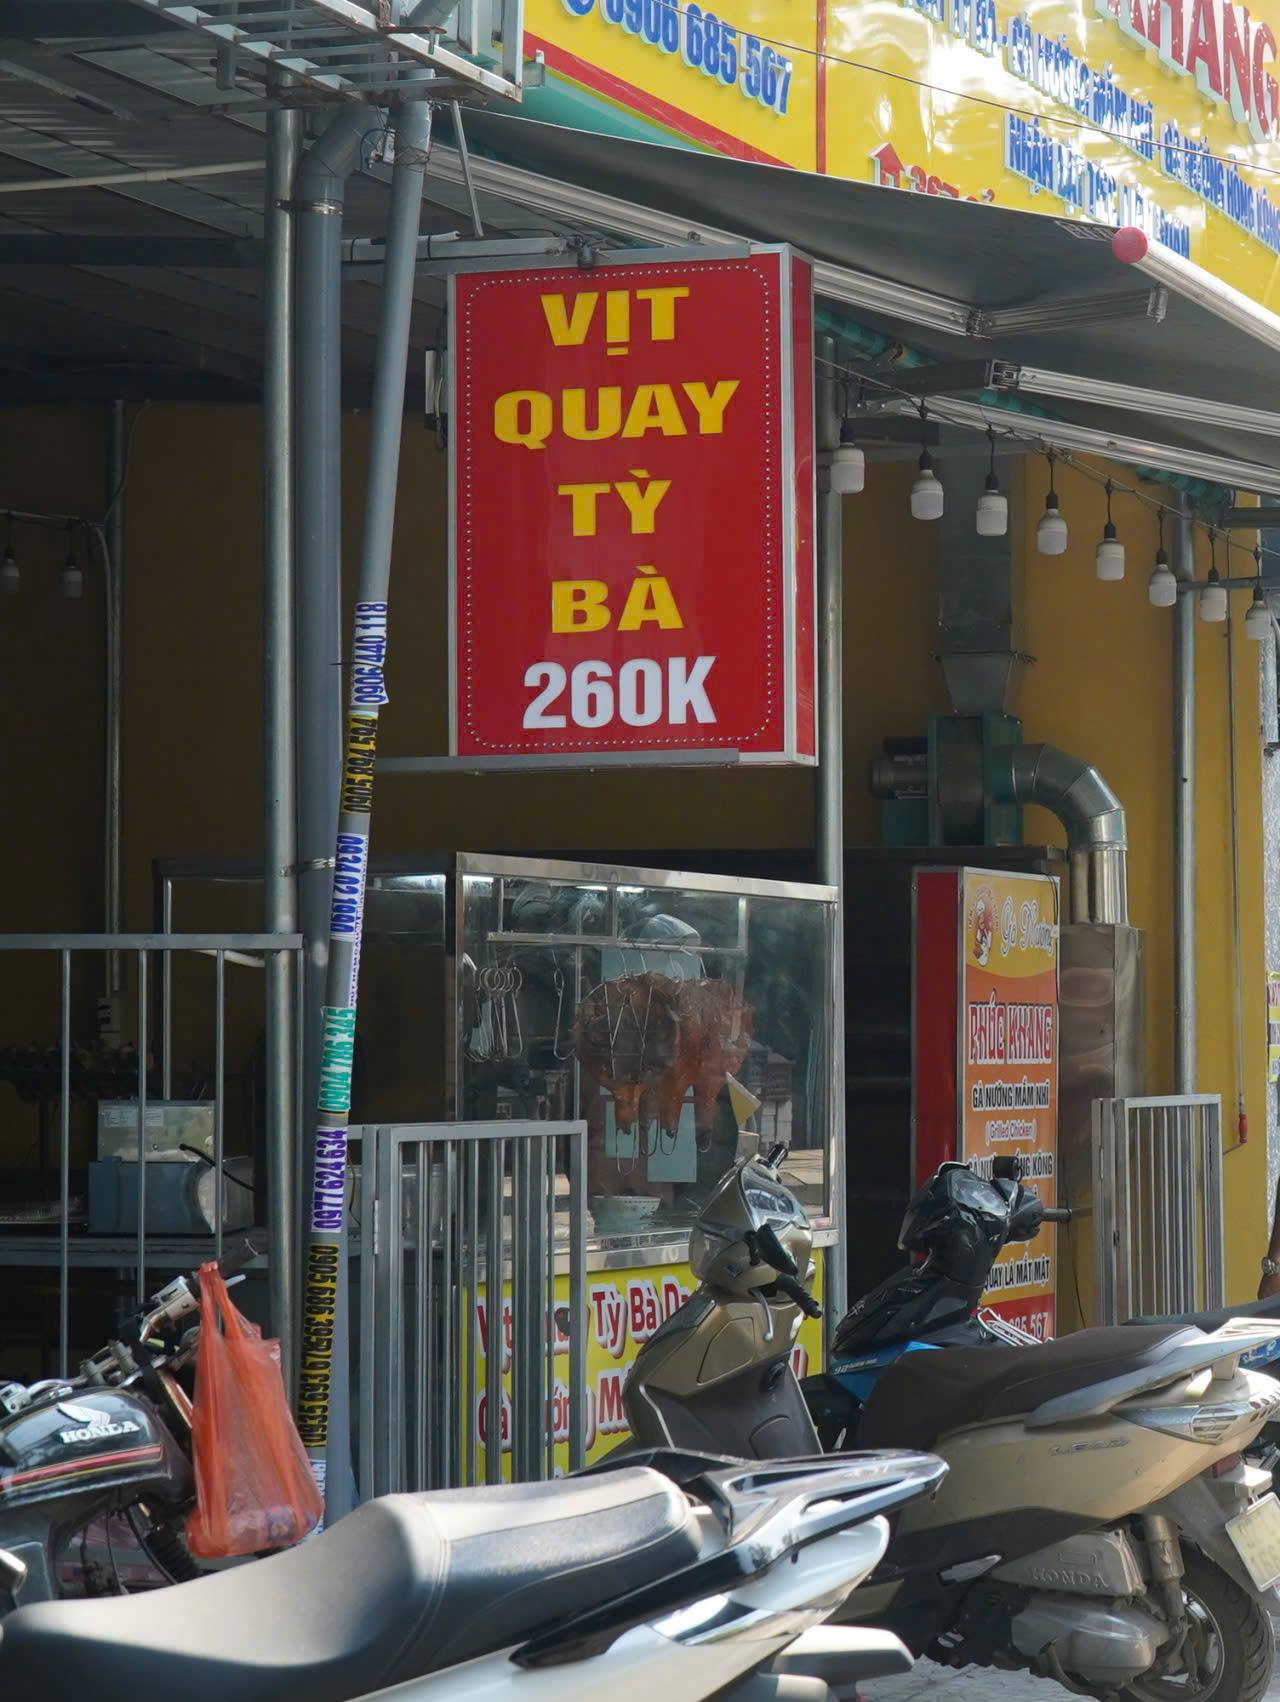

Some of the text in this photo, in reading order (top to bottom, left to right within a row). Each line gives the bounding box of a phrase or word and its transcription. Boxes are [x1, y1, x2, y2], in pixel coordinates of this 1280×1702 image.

[683, 4, 737, 86] 685
[741, 34, 792, 116] 567
[541, 287, 690, 356] VỊT
[494, 380, 740, 449] QUAY
[558, 468, 672, 537] TỲ
[551, 565, 684, 634] BÀ
[353, 603, 388, 704] 0906 440 118
[522, 655, 717, 729] 260K
[330, 834, 365, 933] 0934 02 1990
[324, 1007, 357, 1038] 345
[1007, 1003, 1053, 1064] KHANG
[319, 1071, 351, 1110] 0904
[313, 1130, 347, 1229] 0977 624 634
[1032, 1151, 1053, 1176] KÔNG
[592, 1290, 622, 1348] Tỳ
[629, 1286, 658, 1333] Bà
[59, 1420, 141, 1444] HONDA
[1032, 1566, 1110, 1589] HONDA
